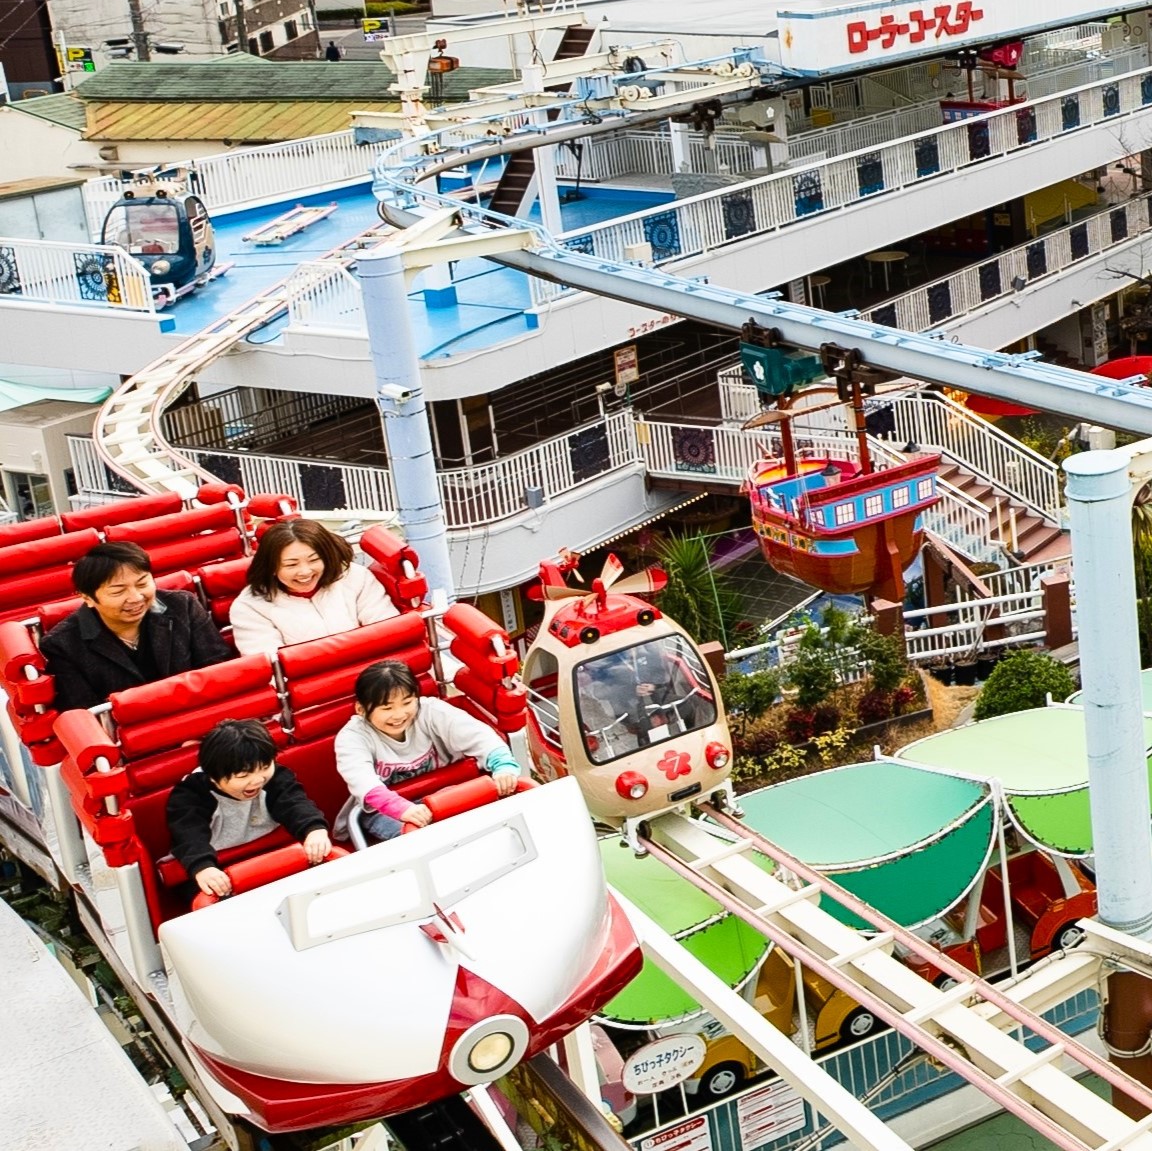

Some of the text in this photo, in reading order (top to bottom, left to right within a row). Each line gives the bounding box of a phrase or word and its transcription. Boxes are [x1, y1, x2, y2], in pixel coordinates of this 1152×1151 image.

[363, 20, 380, 33] P
[847, 1, 983, 53] ローラーコースター
[68, 48, 85, 61] P
[665, 755, 681, 773] 7
[633, 1046, 695, 1076] ちびっ子タクシー
